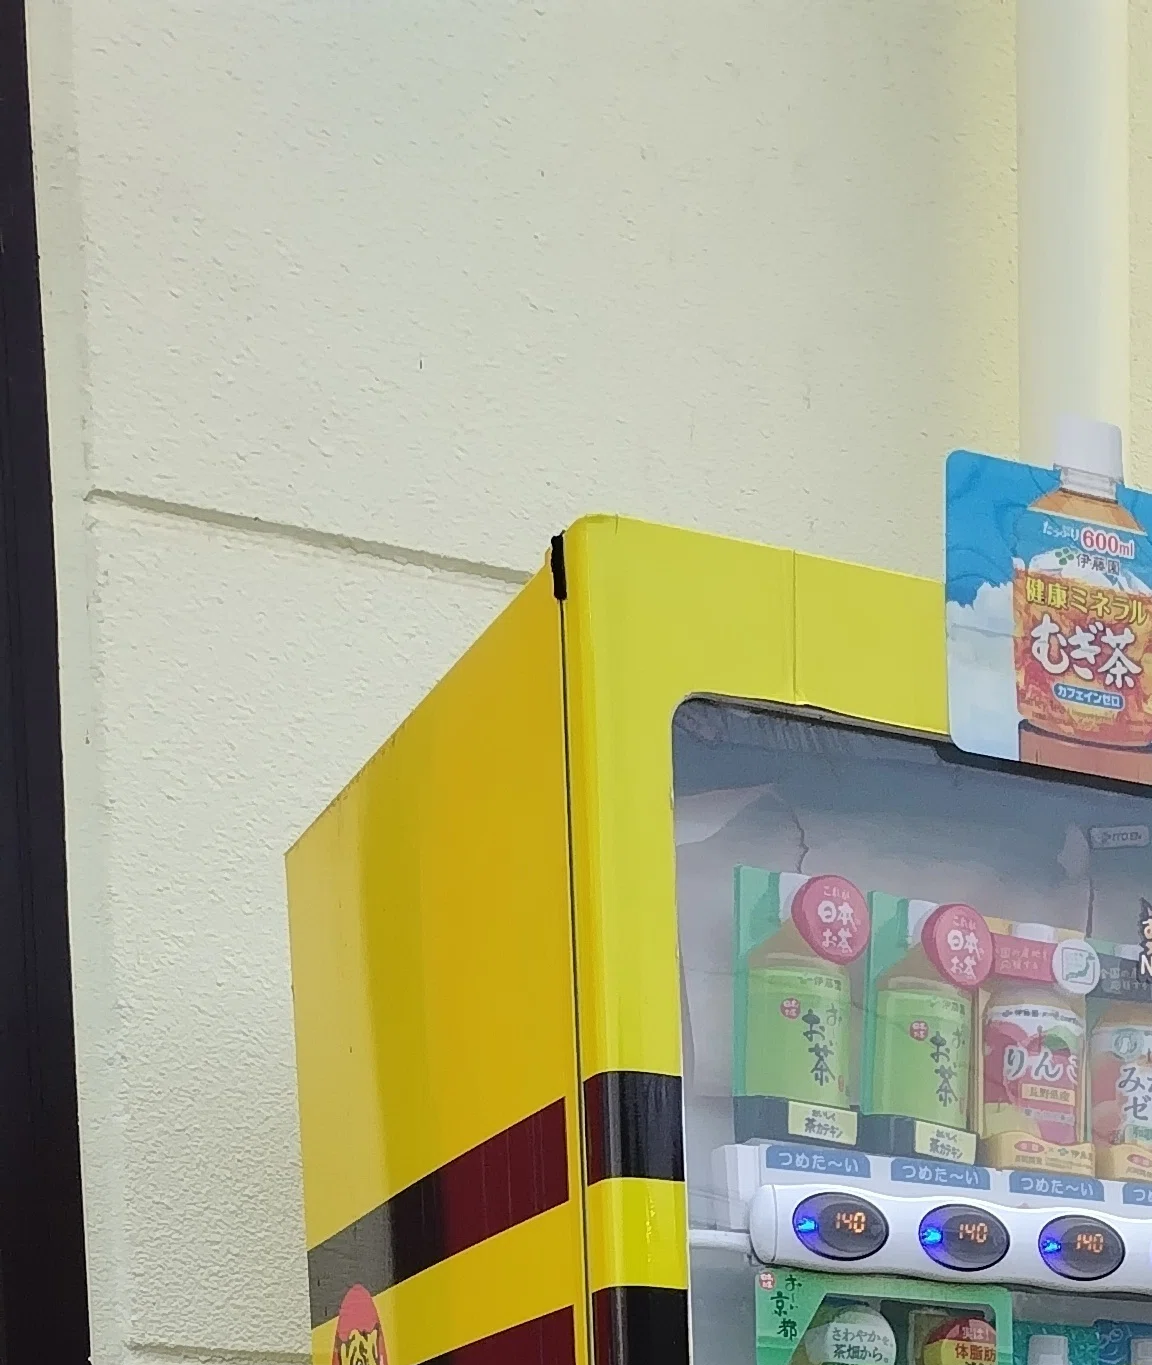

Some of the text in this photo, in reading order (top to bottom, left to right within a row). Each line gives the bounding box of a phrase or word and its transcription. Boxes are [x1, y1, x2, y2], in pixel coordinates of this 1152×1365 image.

[1082, 527, 1135, 557] 600ml
[1077, 554, 1120, 575] 伊藤園
[1026, 577, 1148, 626] 健康ミネラル
[1031, 613, 1142, 688] むぎ茶
[1056, 685, 1121, 708] カフェインゼロ
[802, 1008, 836, 1087] お茶
[929, 1031, 959, 1107] お茶
[835, 1212, 867, 1234] 140
[958, 1222, 989, 1244] 140
[1076, 1233, 1104, 1254] 140
[770, 1290, 798, 1341] 京都
[955, 1343, 997, 1362] 体脂肪
